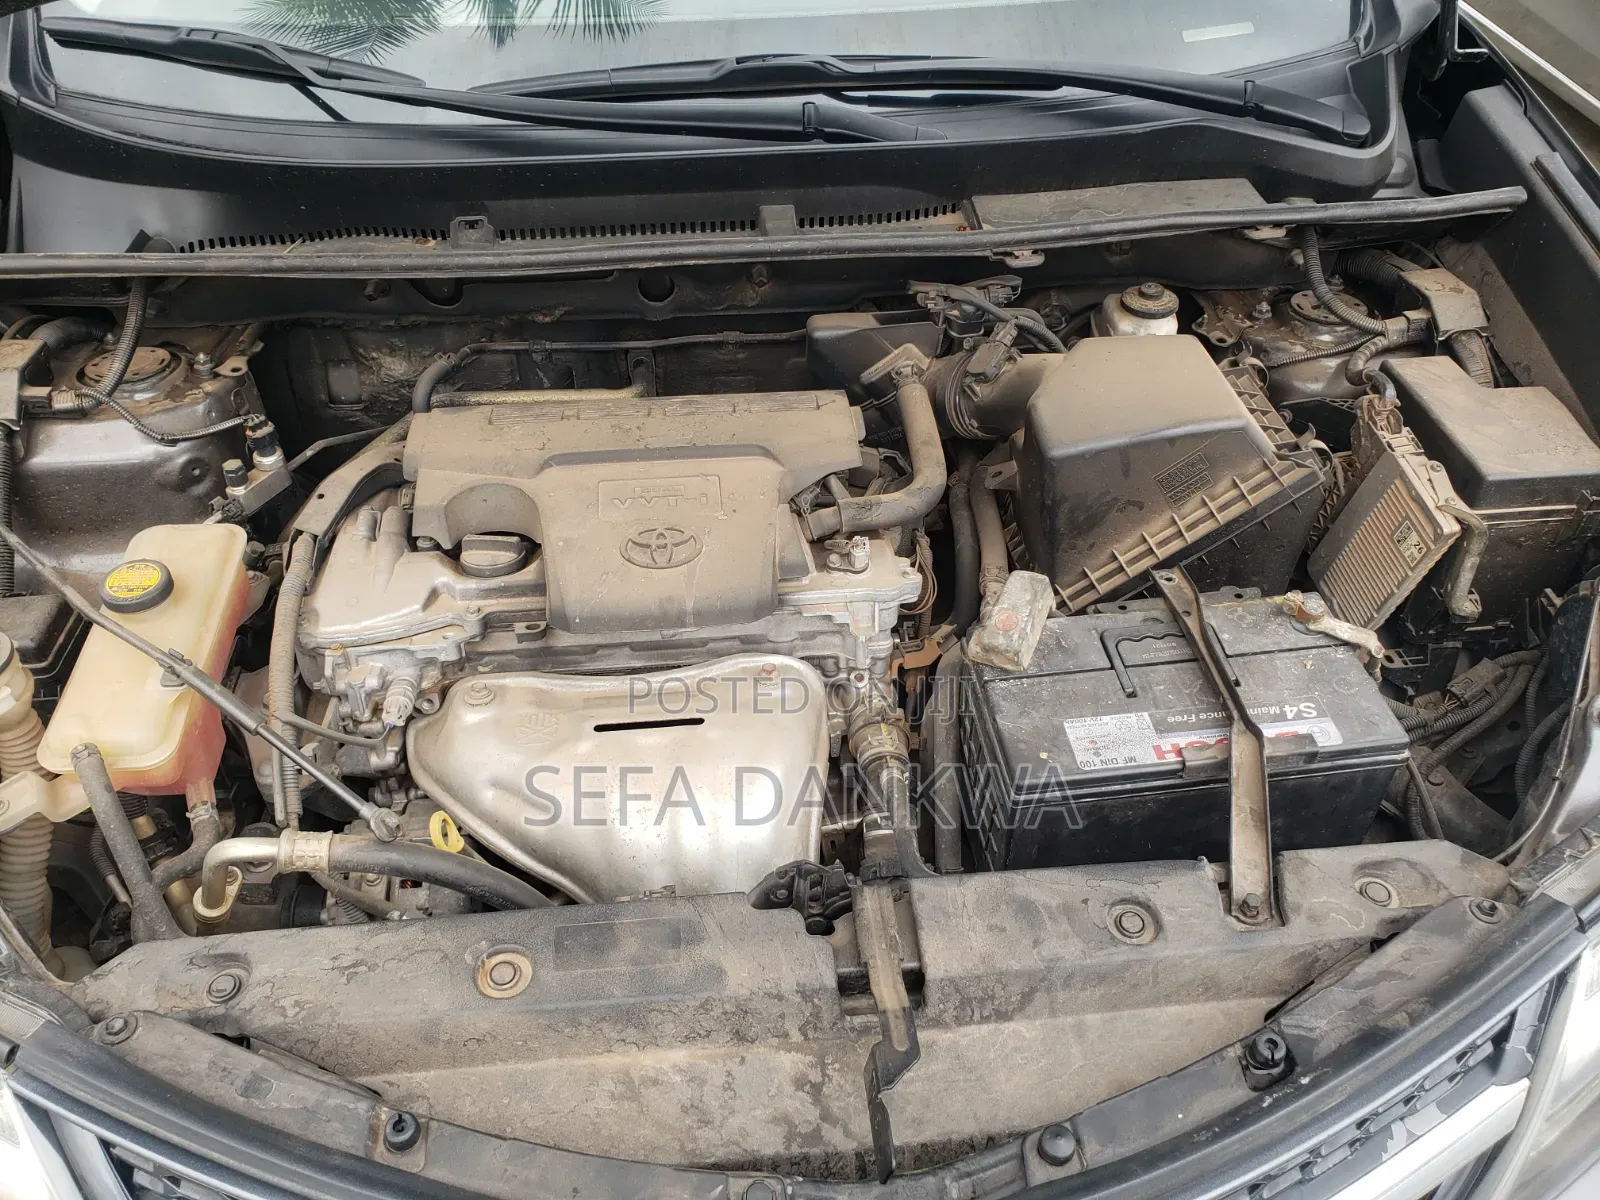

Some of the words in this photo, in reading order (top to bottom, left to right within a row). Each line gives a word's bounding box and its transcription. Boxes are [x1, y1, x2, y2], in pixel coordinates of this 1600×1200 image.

[1413, 541, 1425, 554] 26
[1283, 702, 1318, 720] S4
[1167, 713, 1196, 724] Free
[1079, 760, 1098, 768] 100
[1122, 756, 1137, 764] MF
